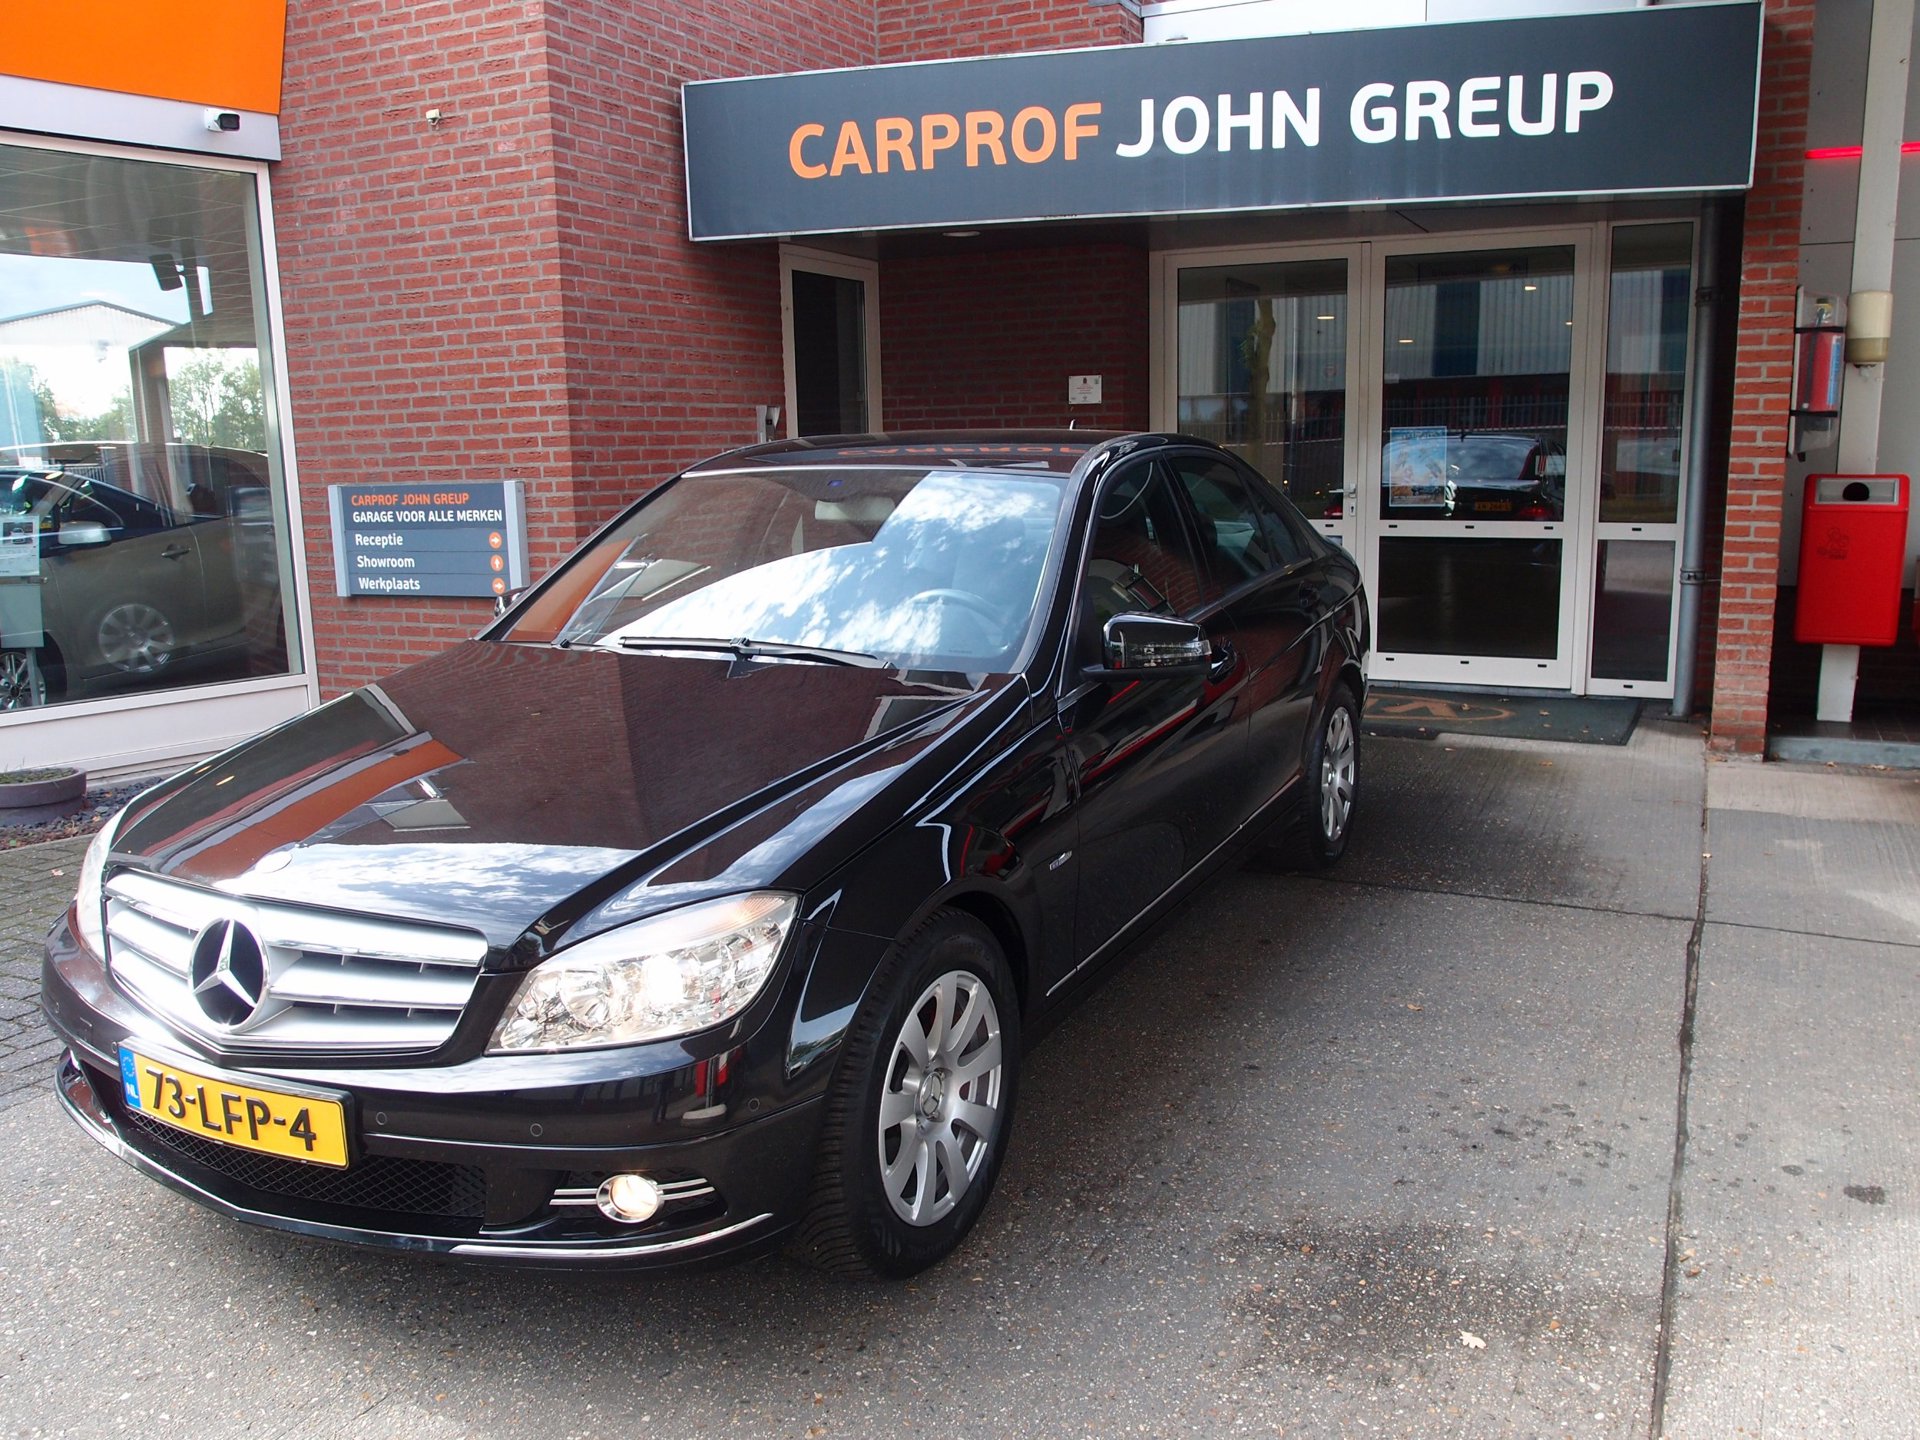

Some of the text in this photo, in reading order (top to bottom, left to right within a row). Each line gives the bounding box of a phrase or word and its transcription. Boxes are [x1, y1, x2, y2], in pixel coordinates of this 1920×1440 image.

[789, 70, 1614, 179] CARPROF JOHN GREUP
[351, 492, 470, 506] CARPROF JOHN GREUP
[353, 509, 503, 523] GARAGE VOOR ALLE MERKEN
[355, 532, 404, 548] Receptie
[357, 555, 415, 568] Showroom
[358, 577, 421, 592] Werkplaats
[125, 1083, 139, 1099] NL
[145, 1066, 317, 1151] 73-LFP-4
